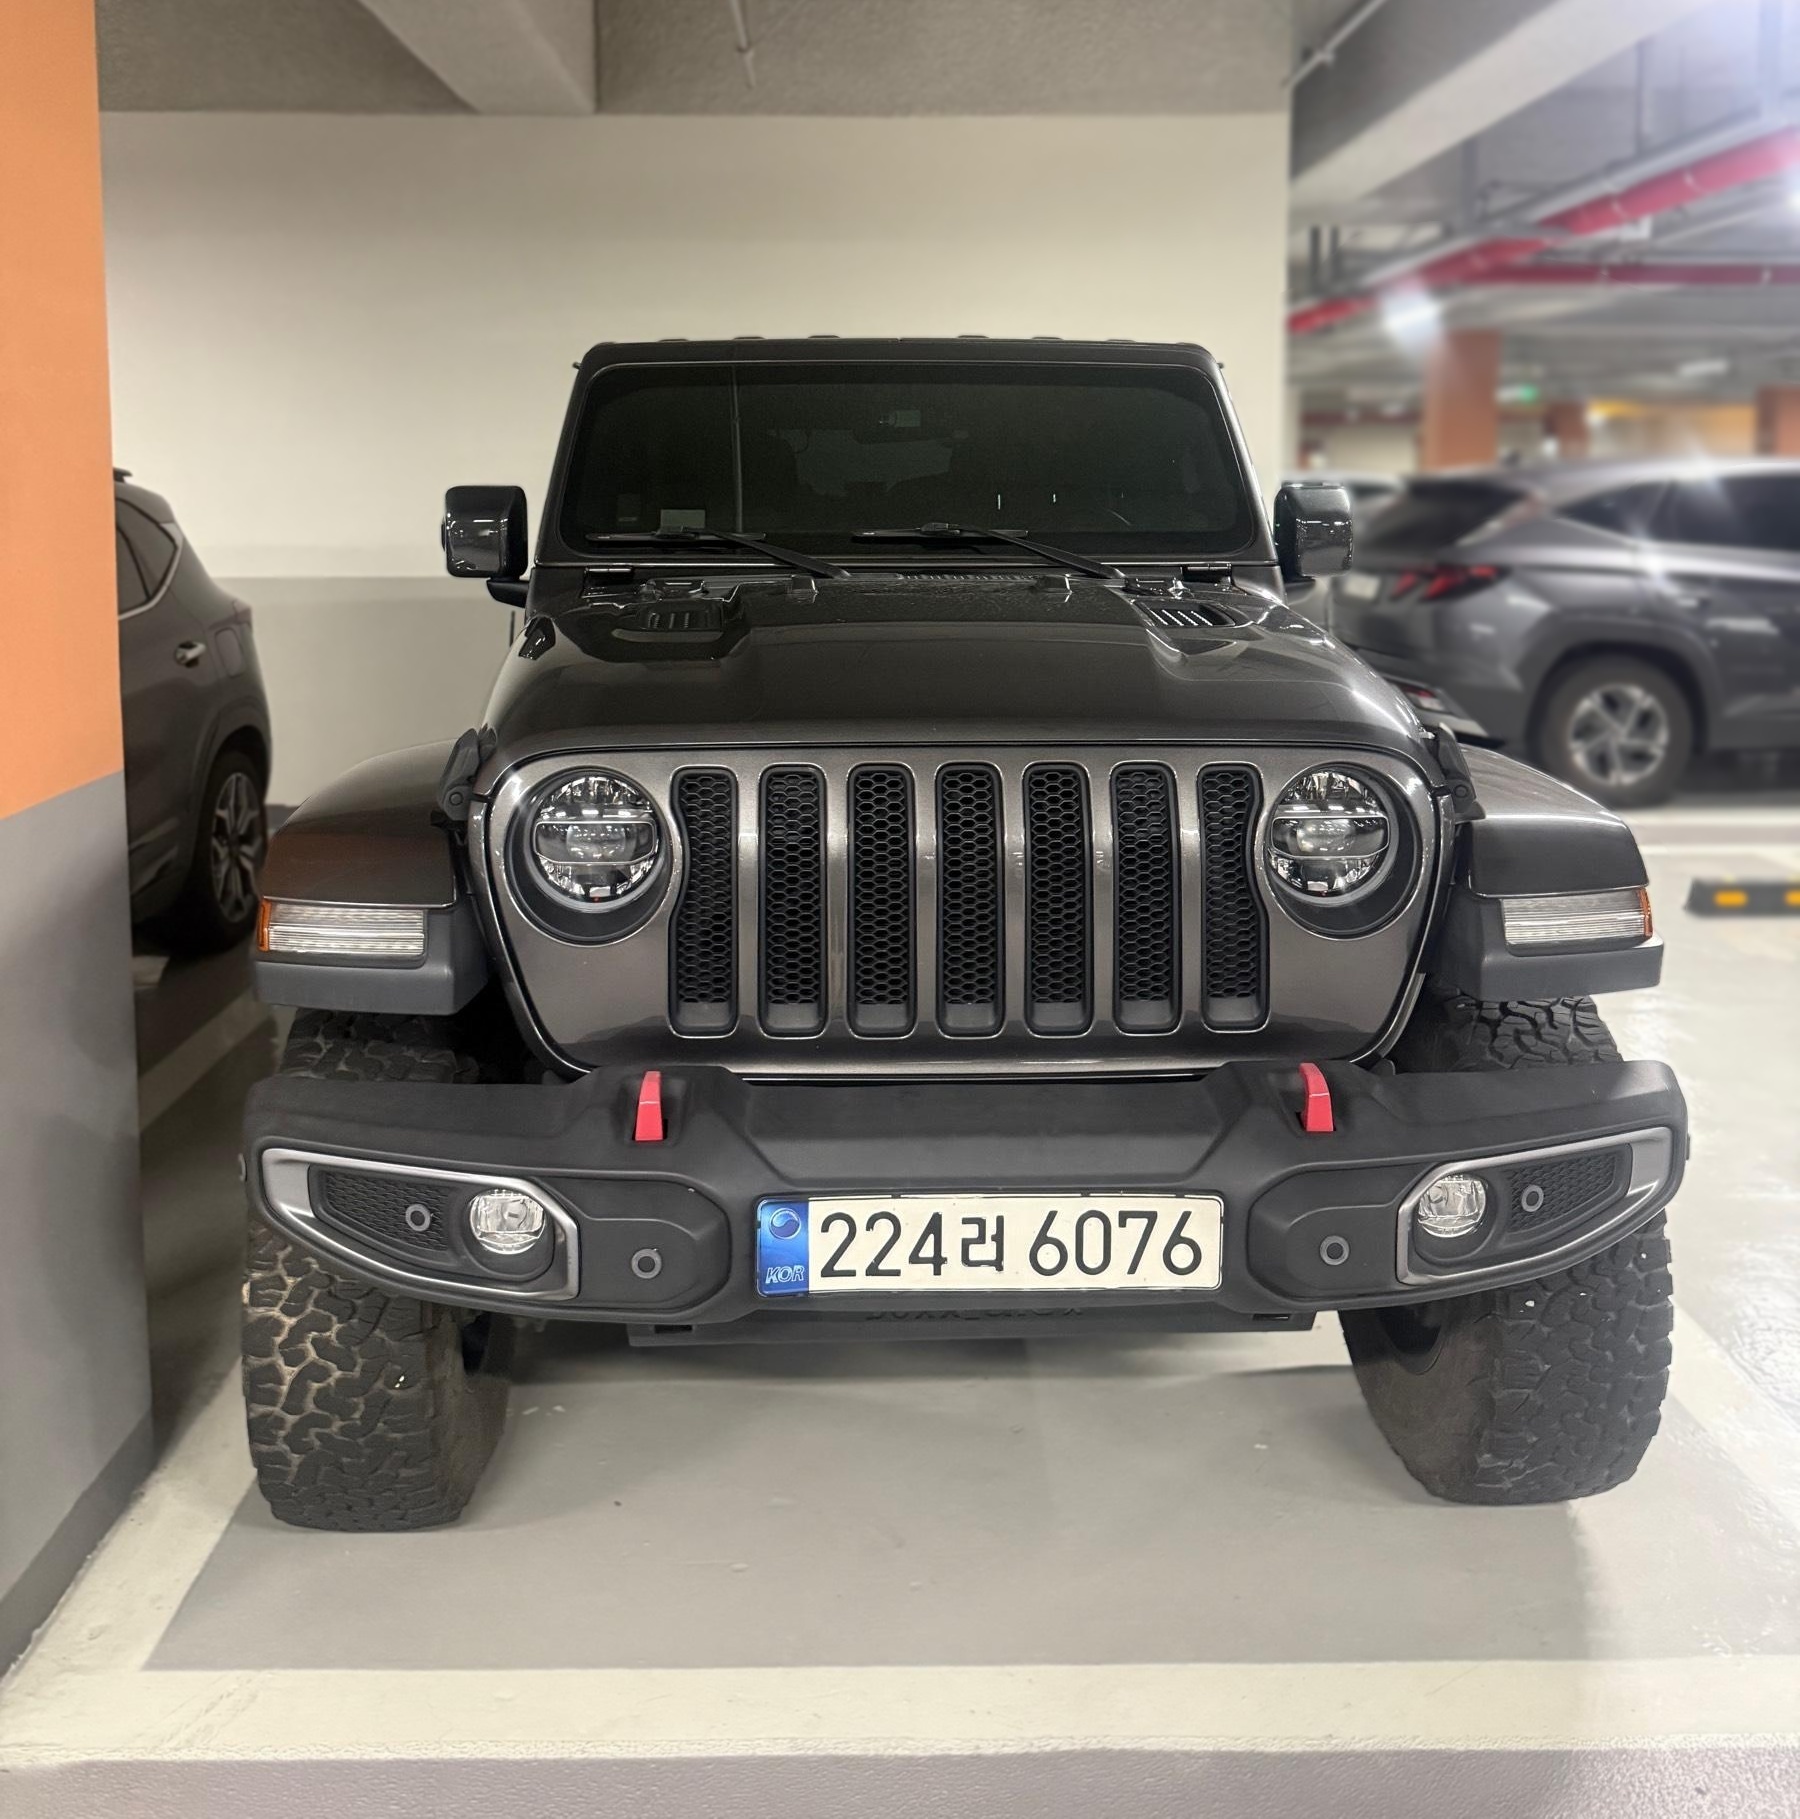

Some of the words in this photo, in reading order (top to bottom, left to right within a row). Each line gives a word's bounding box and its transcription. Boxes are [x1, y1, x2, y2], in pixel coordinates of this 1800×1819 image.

[820, 1212, 1004, 1277] 224러
[1029, 1210, 1202, 1276] 6076
[765, 1265, 805, 1284] KOR
